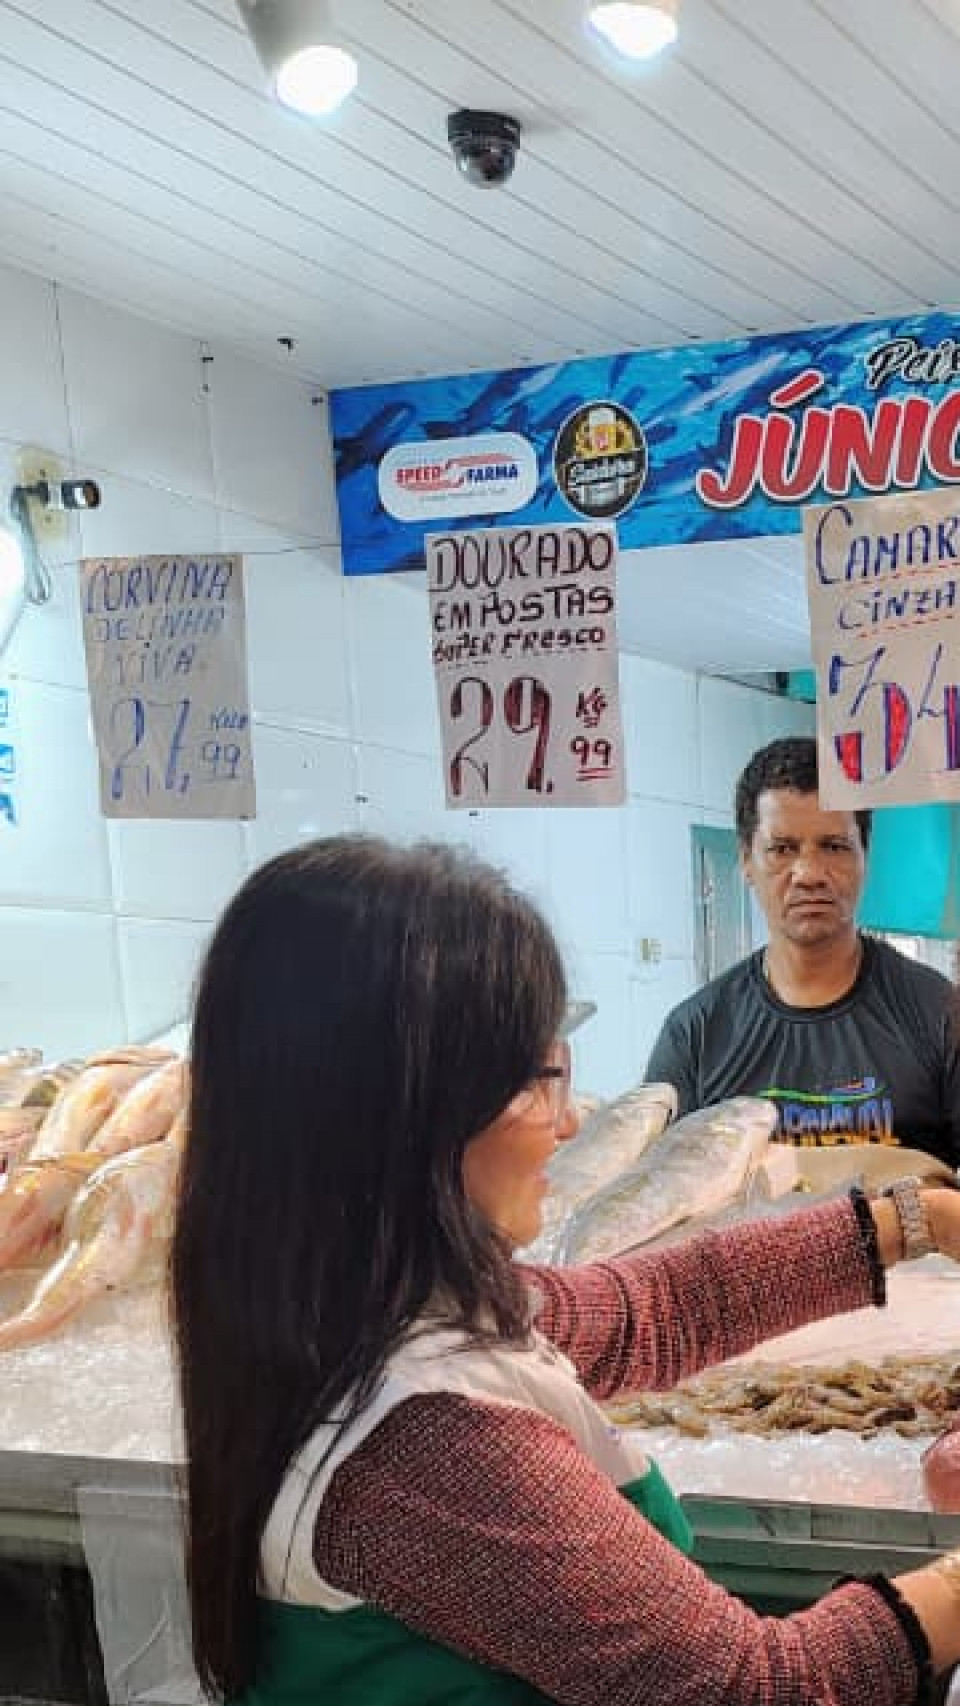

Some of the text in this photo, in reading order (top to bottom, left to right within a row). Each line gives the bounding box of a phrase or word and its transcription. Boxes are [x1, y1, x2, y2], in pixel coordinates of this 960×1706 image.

[396, 463, 518, 483] SPEED FARMA
[427, 527, 614, 592] DOURADO
[433, 584, 615, 633] EM POSTAS
[201, 739, 241, 782] 99
[571, 736, 612, 767] 99
